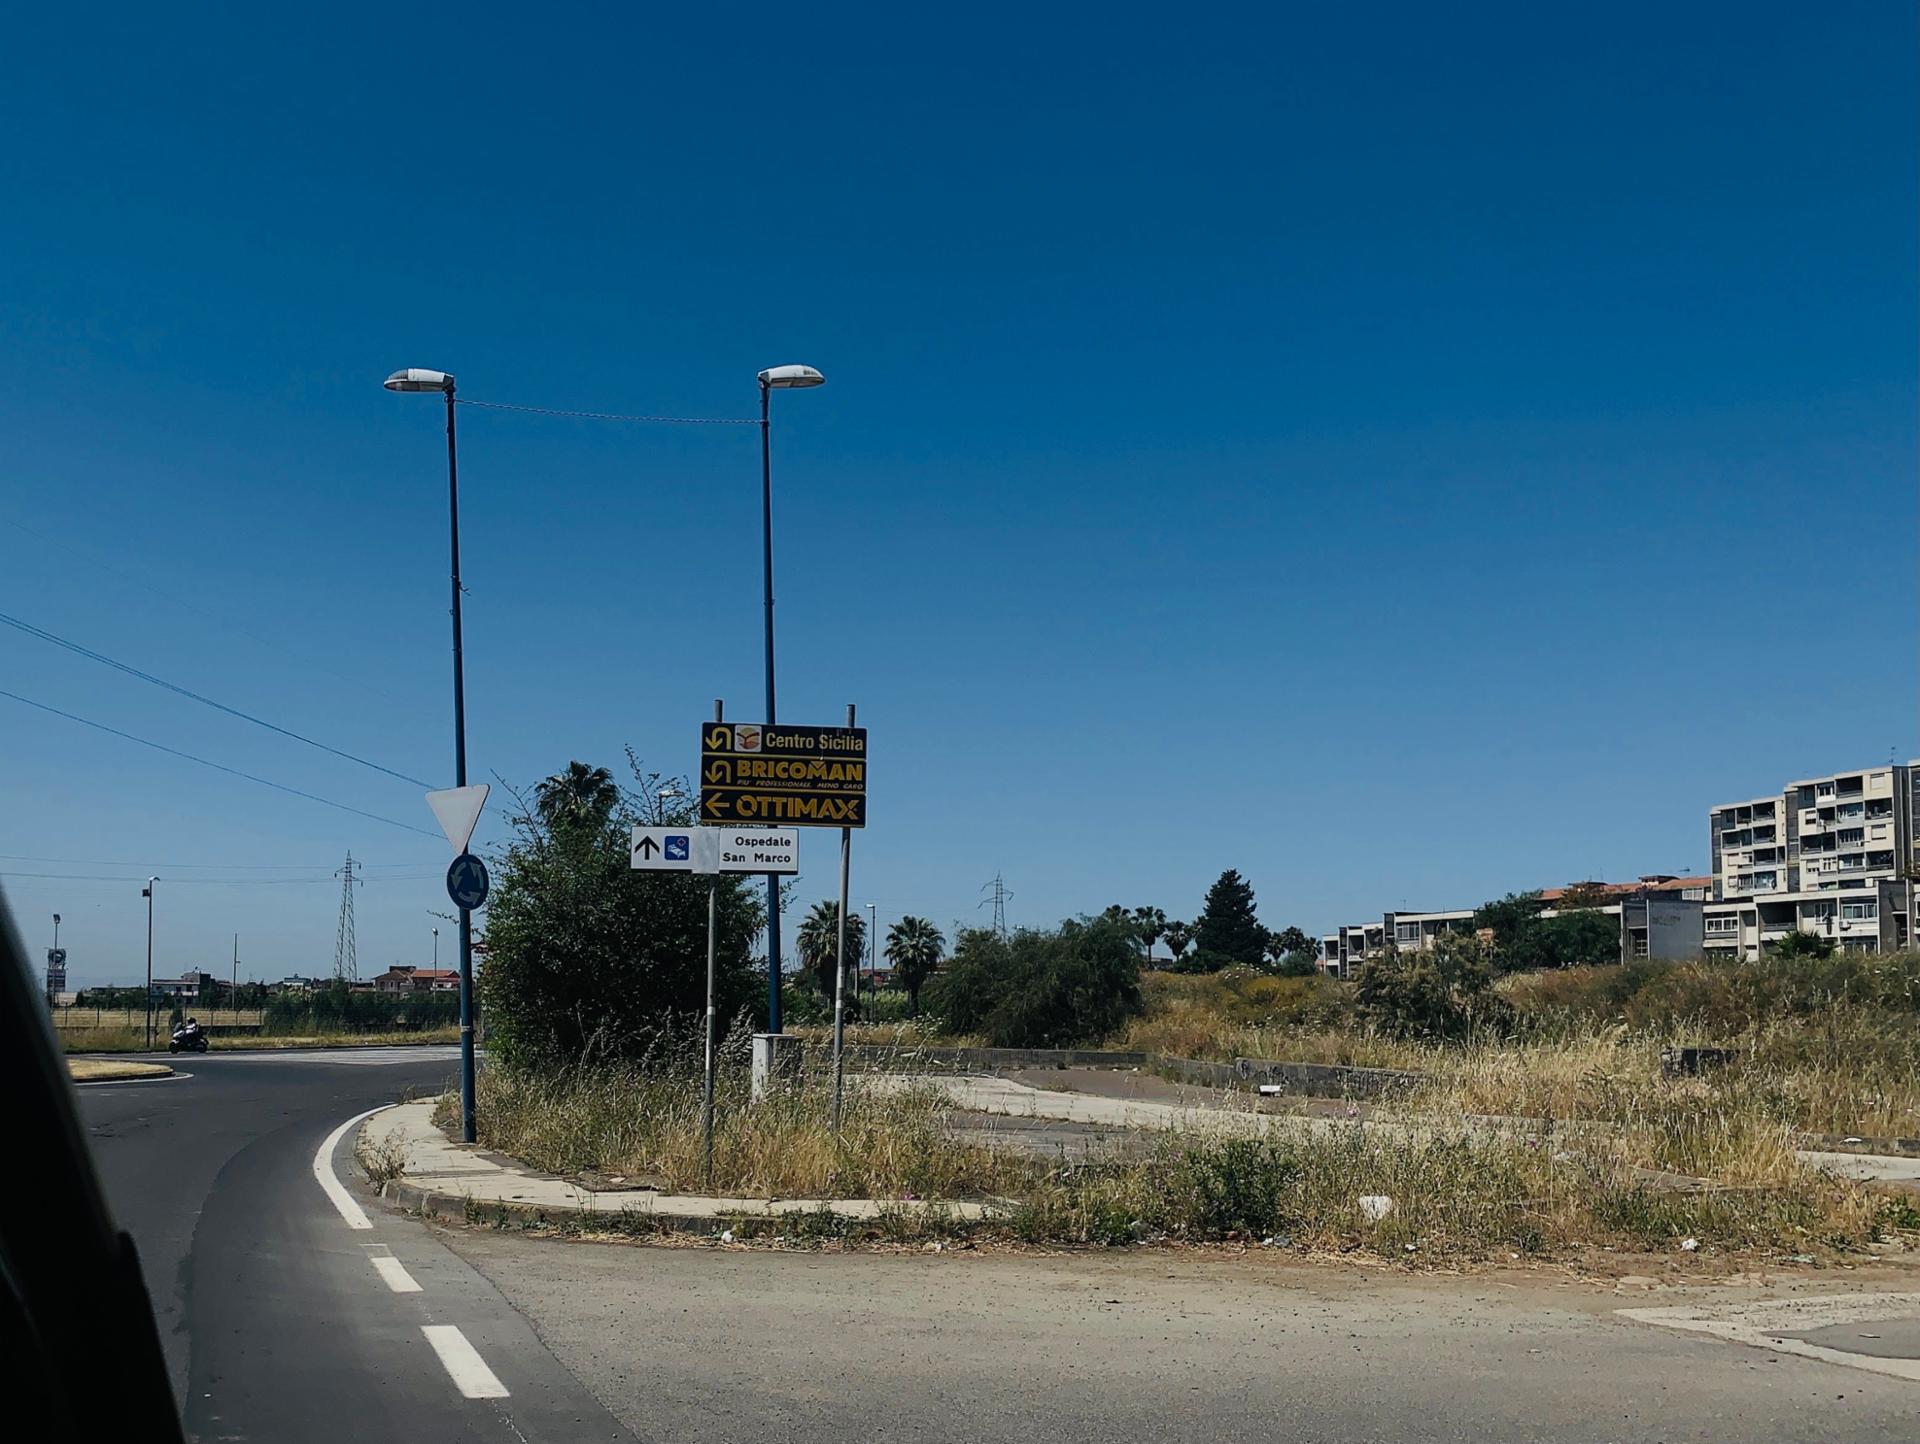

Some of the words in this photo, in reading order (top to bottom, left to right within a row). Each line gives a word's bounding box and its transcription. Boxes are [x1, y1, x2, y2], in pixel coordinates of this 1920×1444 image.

[766, 732, 814, 749] Centro
[818, 734, 864, 751] Sicilia
[737, 760, 863, 781] BRICOMAN
[735, 794, 860, 820] OTTIMAX
[735, 836, 791, 848] Ospedale
[722, 852, 746, 863] San
[754, 853, 791, 863] Marco
